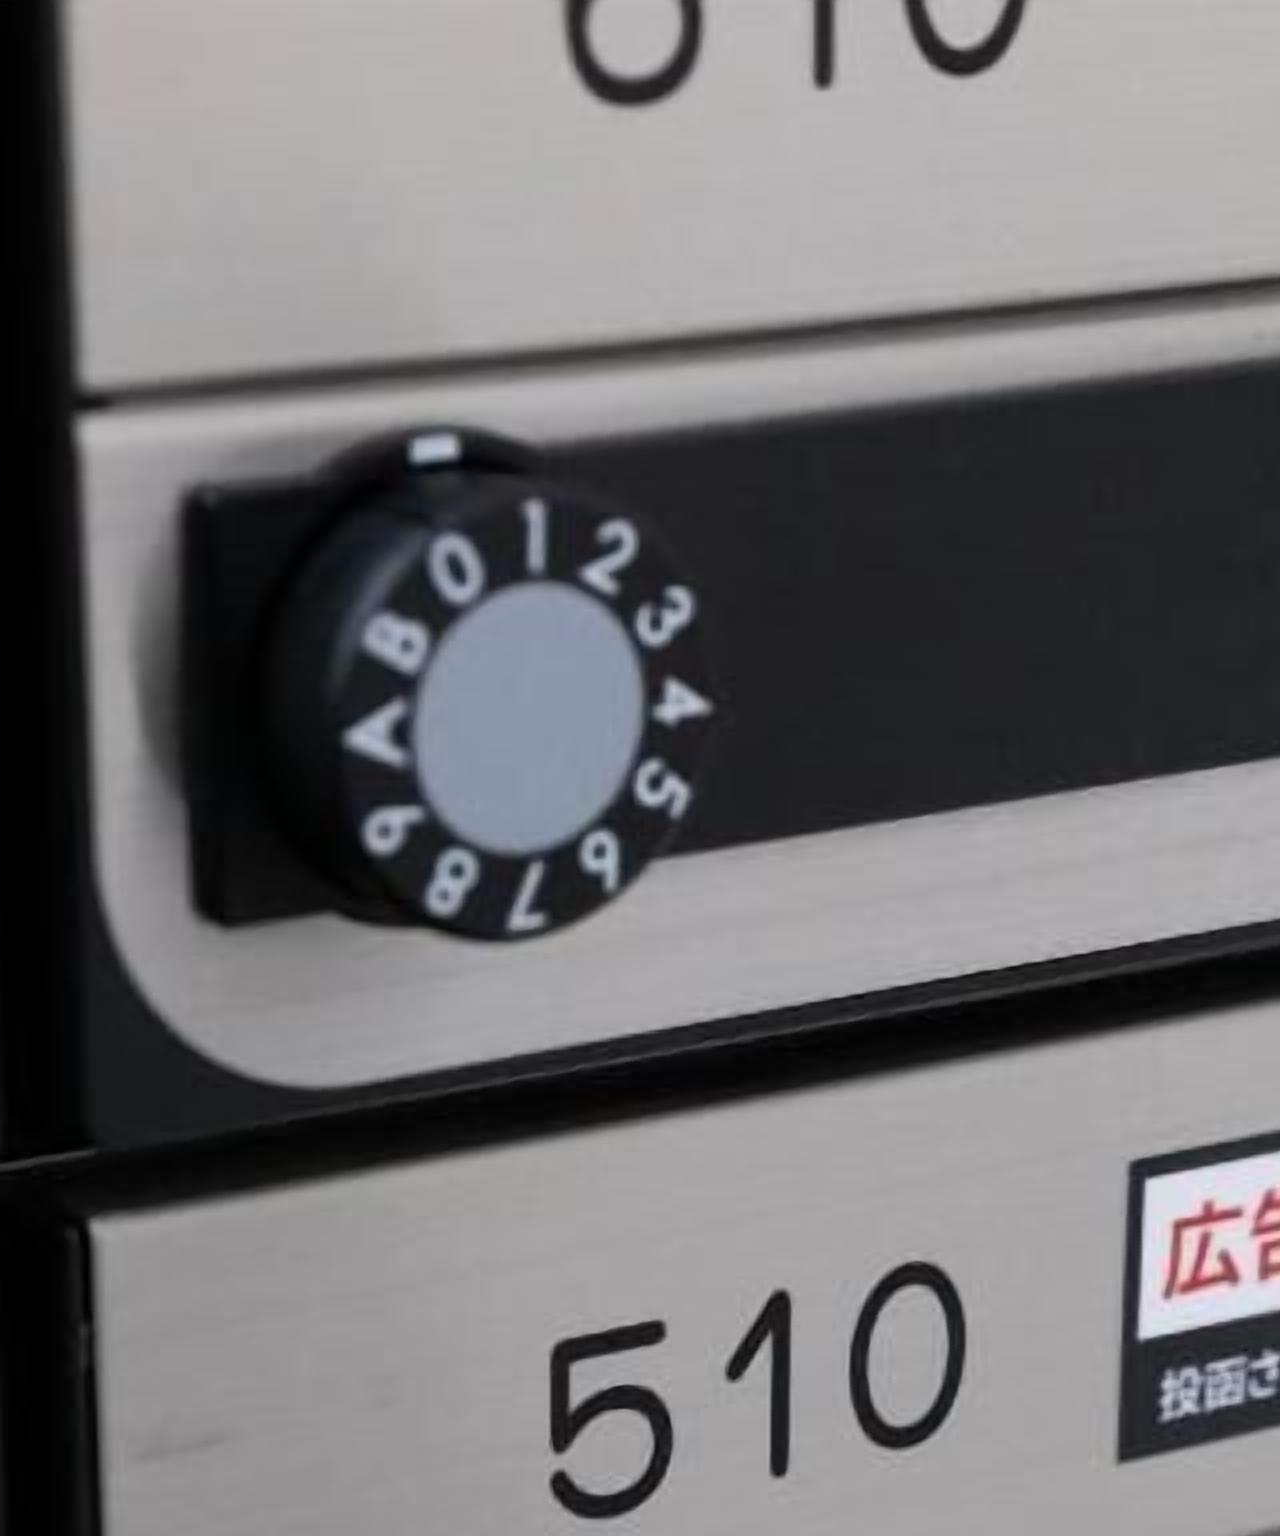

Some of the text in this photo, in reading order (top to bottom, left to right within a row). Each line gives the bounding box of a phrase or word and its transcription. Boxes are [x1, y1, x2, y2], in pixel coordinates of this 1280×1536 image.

[342, 498, 713, 932] 0 1 2 3 4 5 6 7 8 9 A B
[549, 1259, 966, 1520] 510
